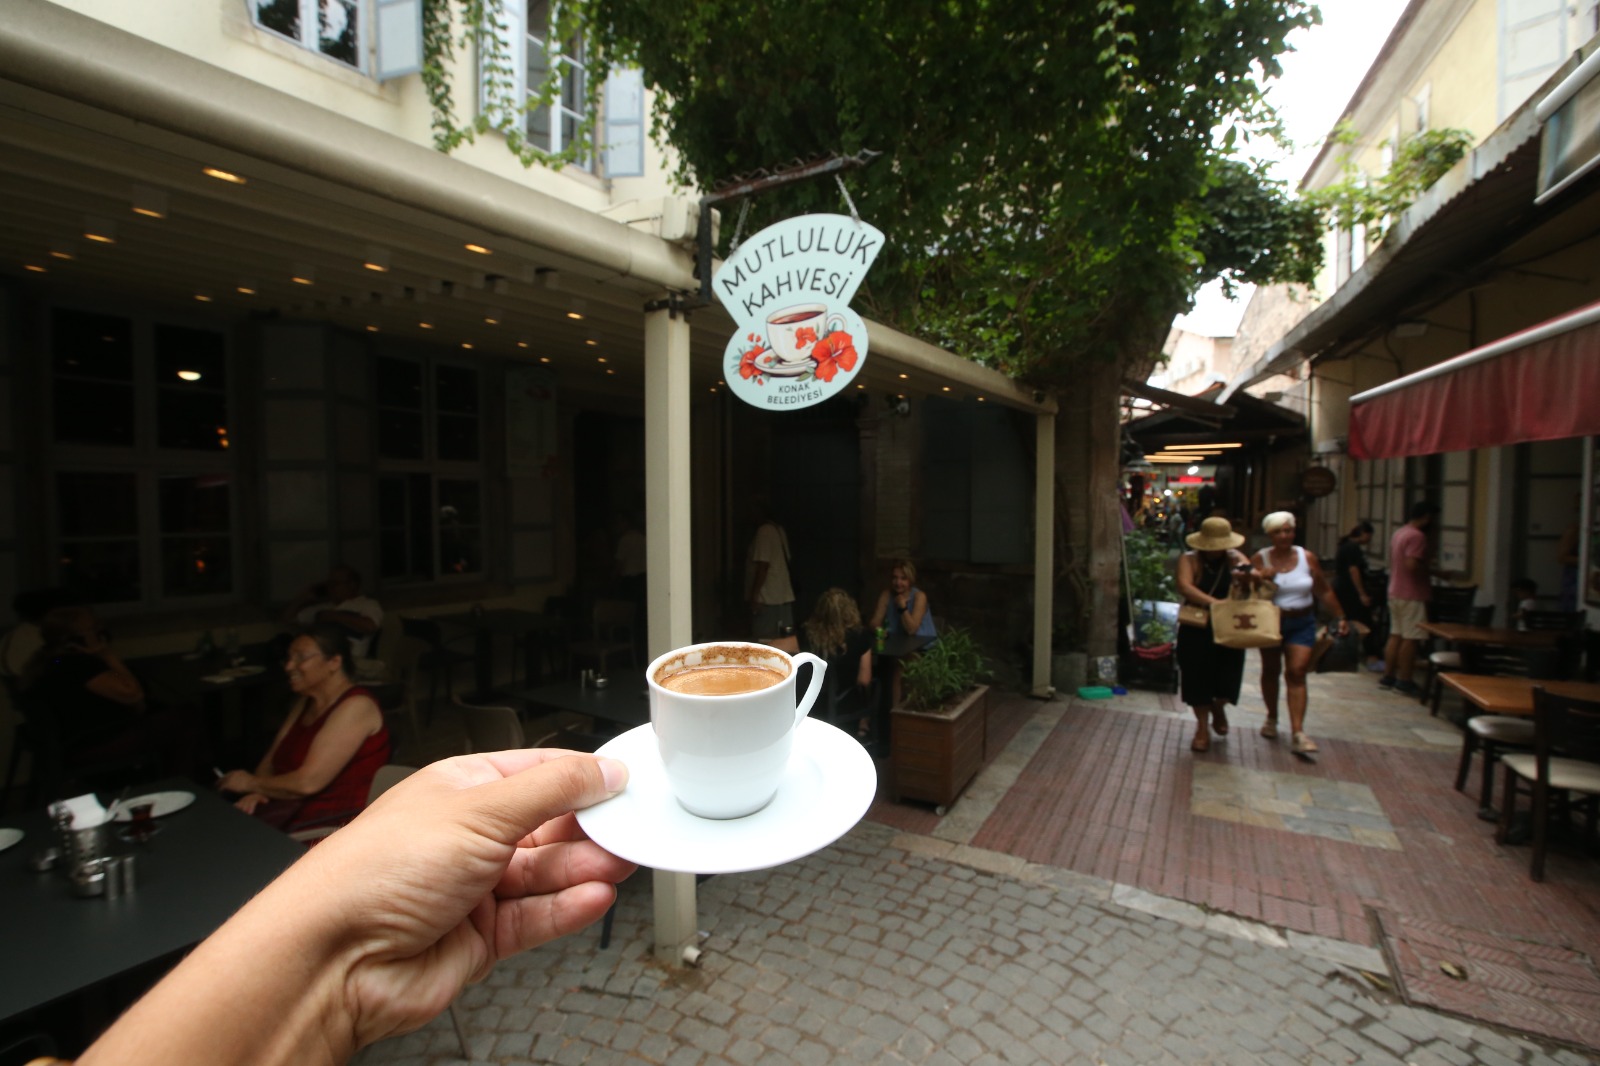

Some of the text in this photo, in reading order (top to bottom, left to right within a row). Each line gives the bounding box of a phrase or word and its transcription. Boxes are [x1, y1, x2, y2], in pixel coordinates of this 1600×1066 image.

[721, 227, 876, 295] MUTLULUK
[742, 267, 853, 317] KAHVESİ
[767, 389, 823, 404] BELEDİYESİ
[778, 383, 810, 393] KONAK
